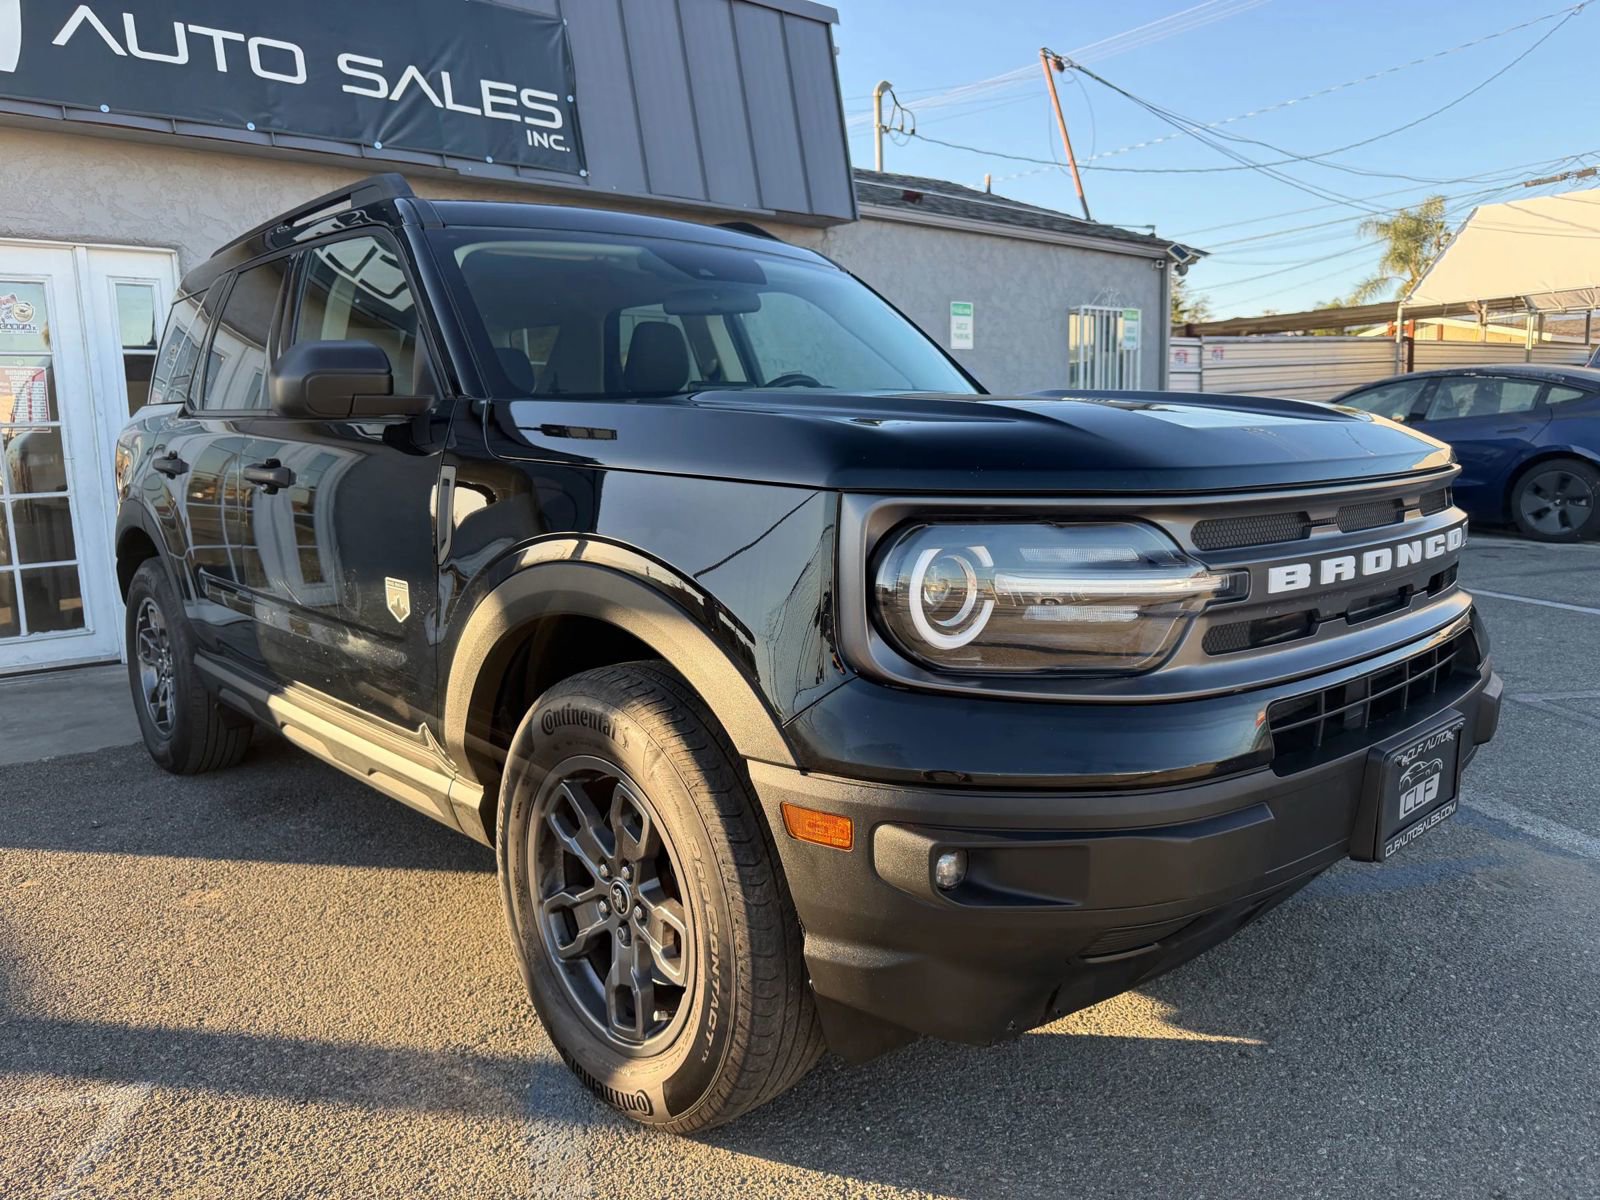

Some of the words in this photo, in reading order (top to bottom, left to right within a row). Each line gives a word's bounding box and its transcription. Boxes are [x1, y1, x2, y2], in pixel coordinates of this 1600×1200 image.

[52, 4, 307, 85] AUTO
[337, 52, 563, 129] SALES
[526, 129, 571, 152] INC.
[1268, 527, 1464, 594] BRONCO
[541, 702, 618, 740] Continental
